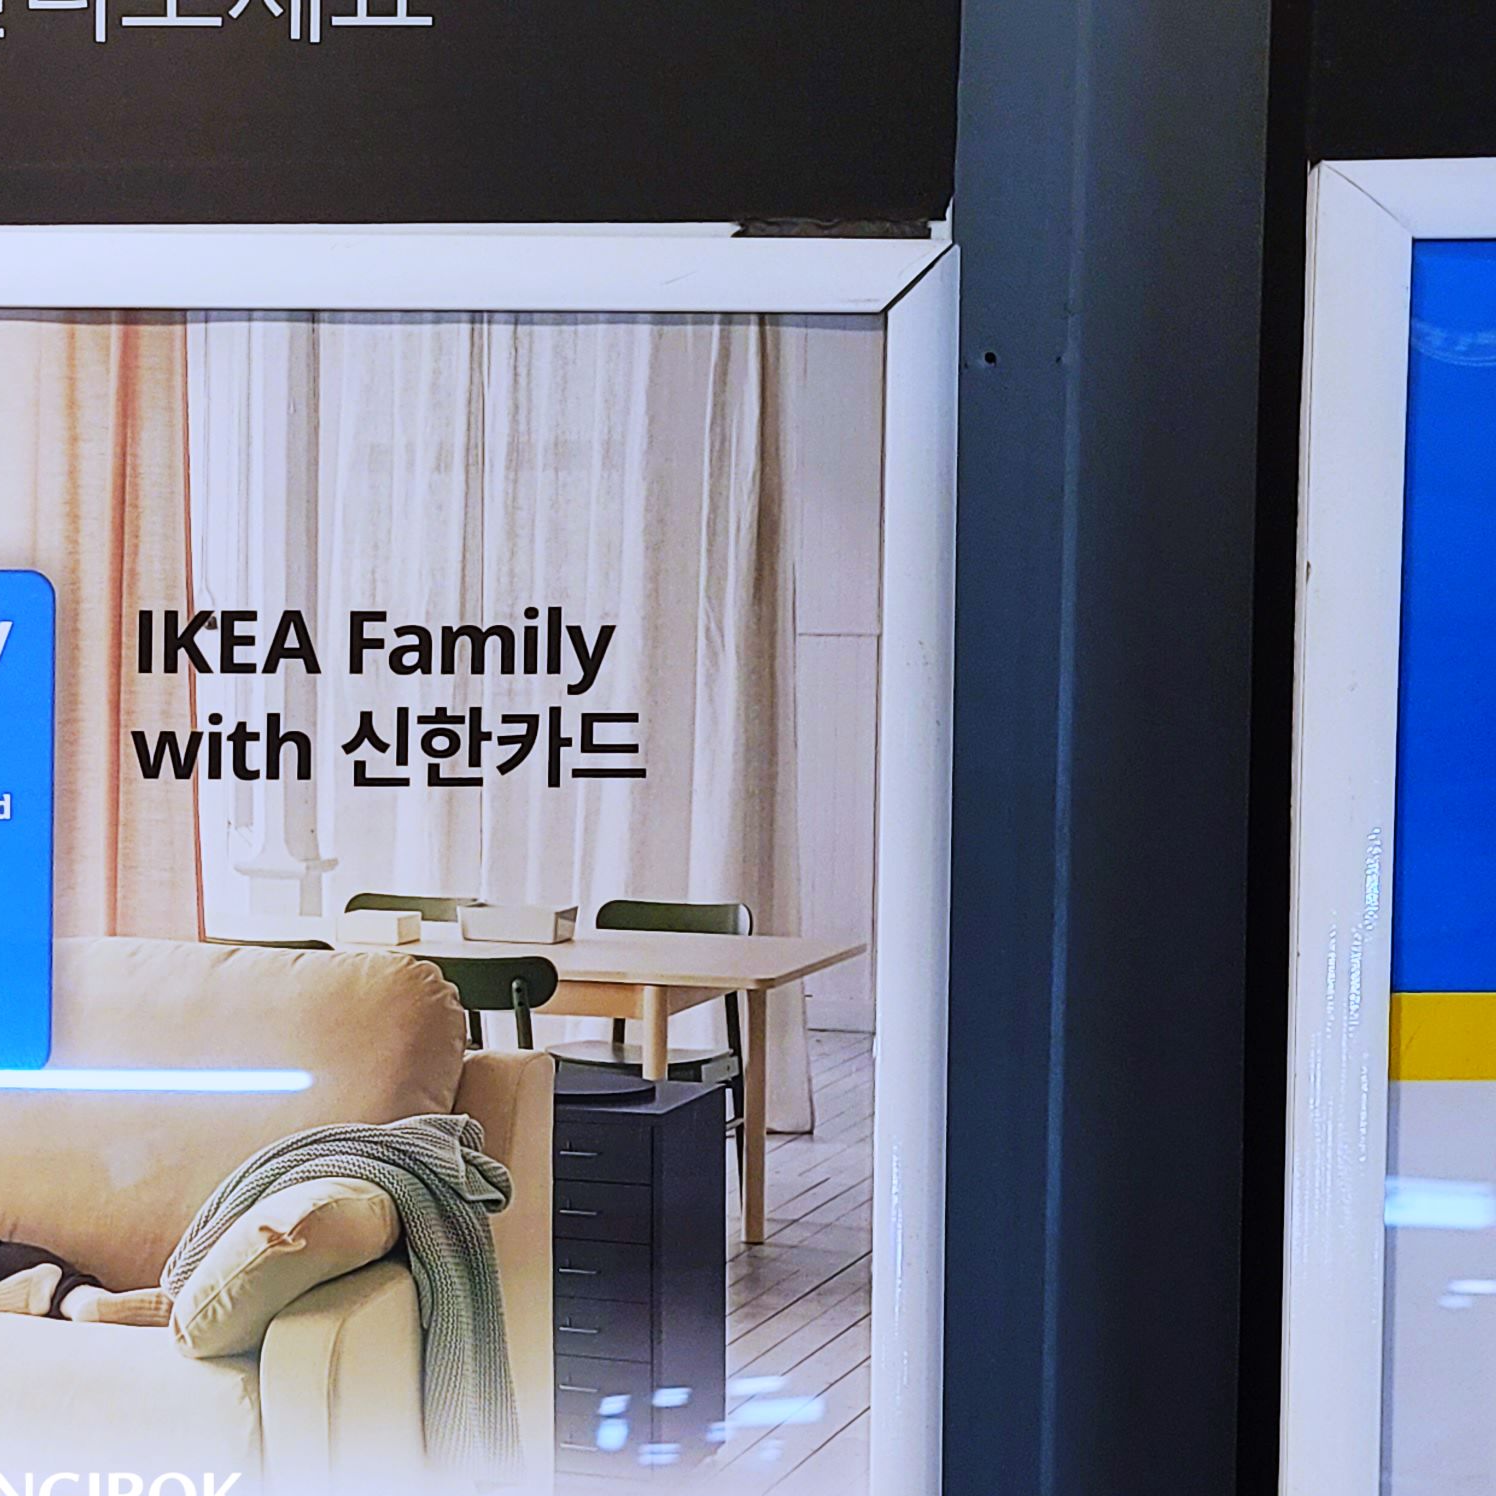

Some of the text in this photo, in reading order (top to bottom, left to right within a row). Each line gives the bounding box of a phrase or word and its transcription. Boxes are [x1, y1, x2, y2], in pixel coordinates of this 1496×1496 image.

[136, 605, 616, 696] IKEA Family
[131, 705, 648, 788] with 신한카드
